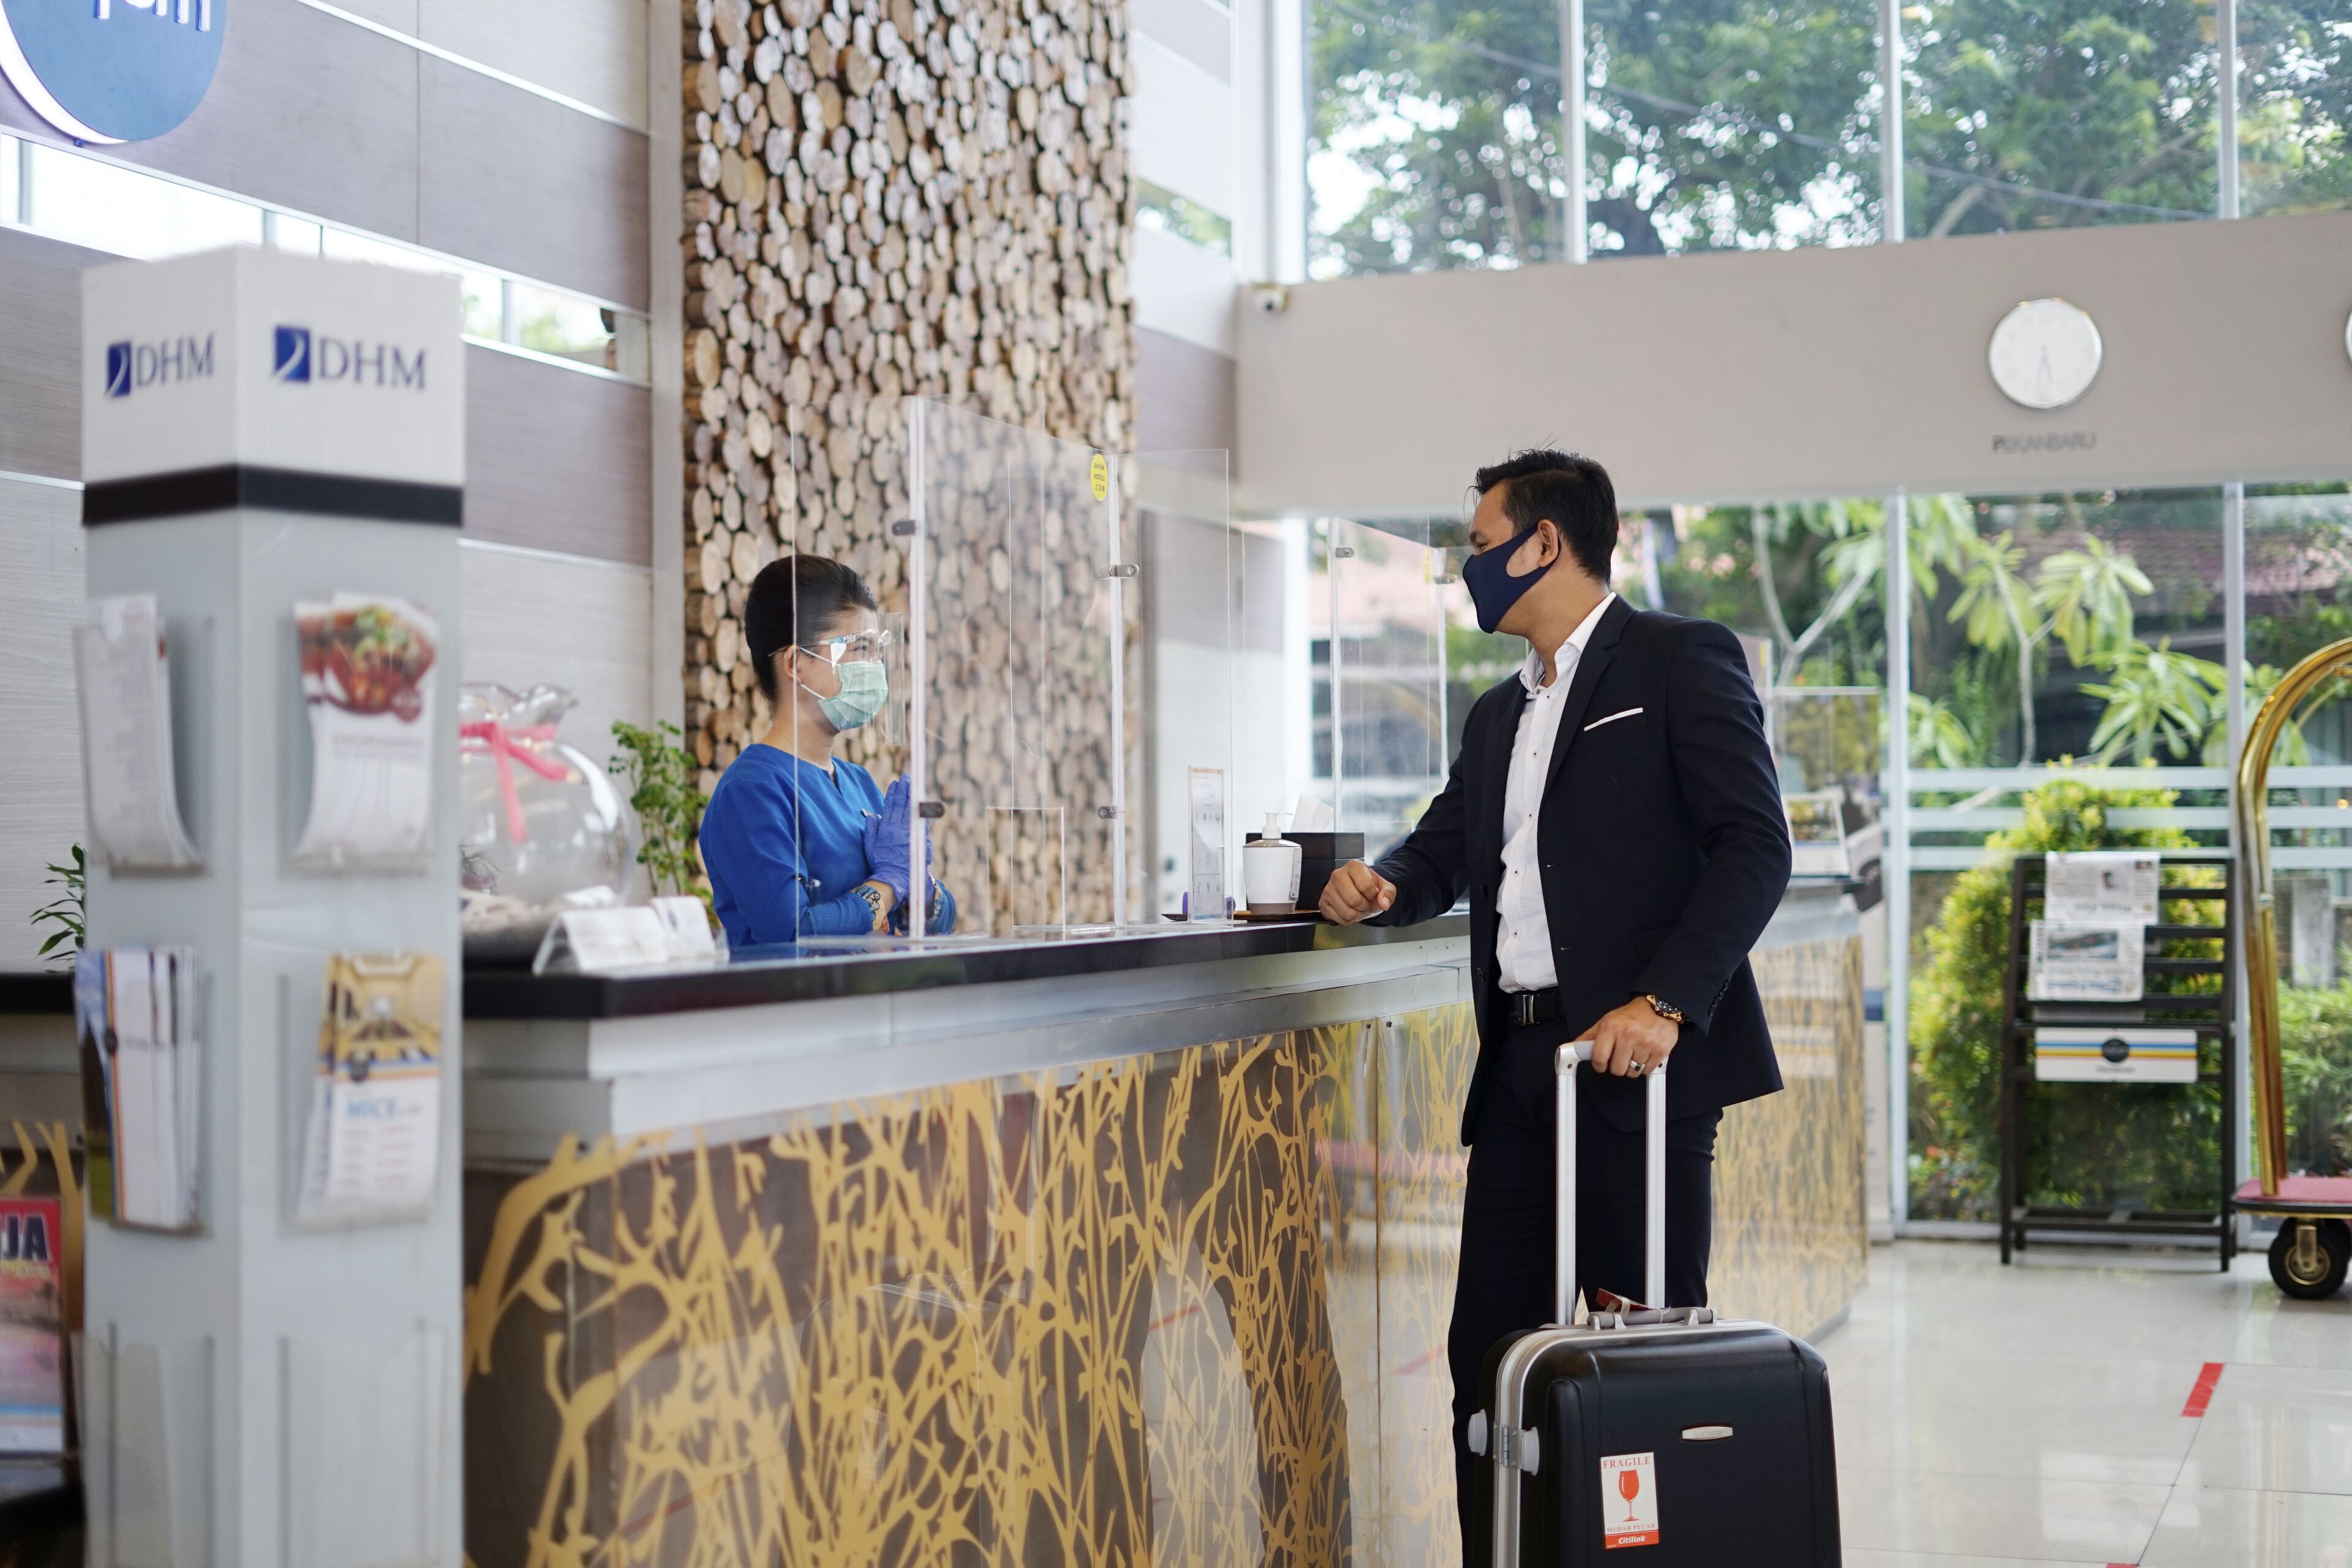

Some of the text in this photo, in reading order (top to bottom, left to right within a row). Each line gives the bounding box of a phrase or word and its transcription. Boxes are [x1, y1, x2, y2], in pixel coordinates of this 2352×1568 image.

[135, 333, 215, 387] DHM
[319, 336, 427, 391] DHM
[0, 1214, 48, 1262] JA
[1604, 1456, 1651, 1469] FRAGILE
